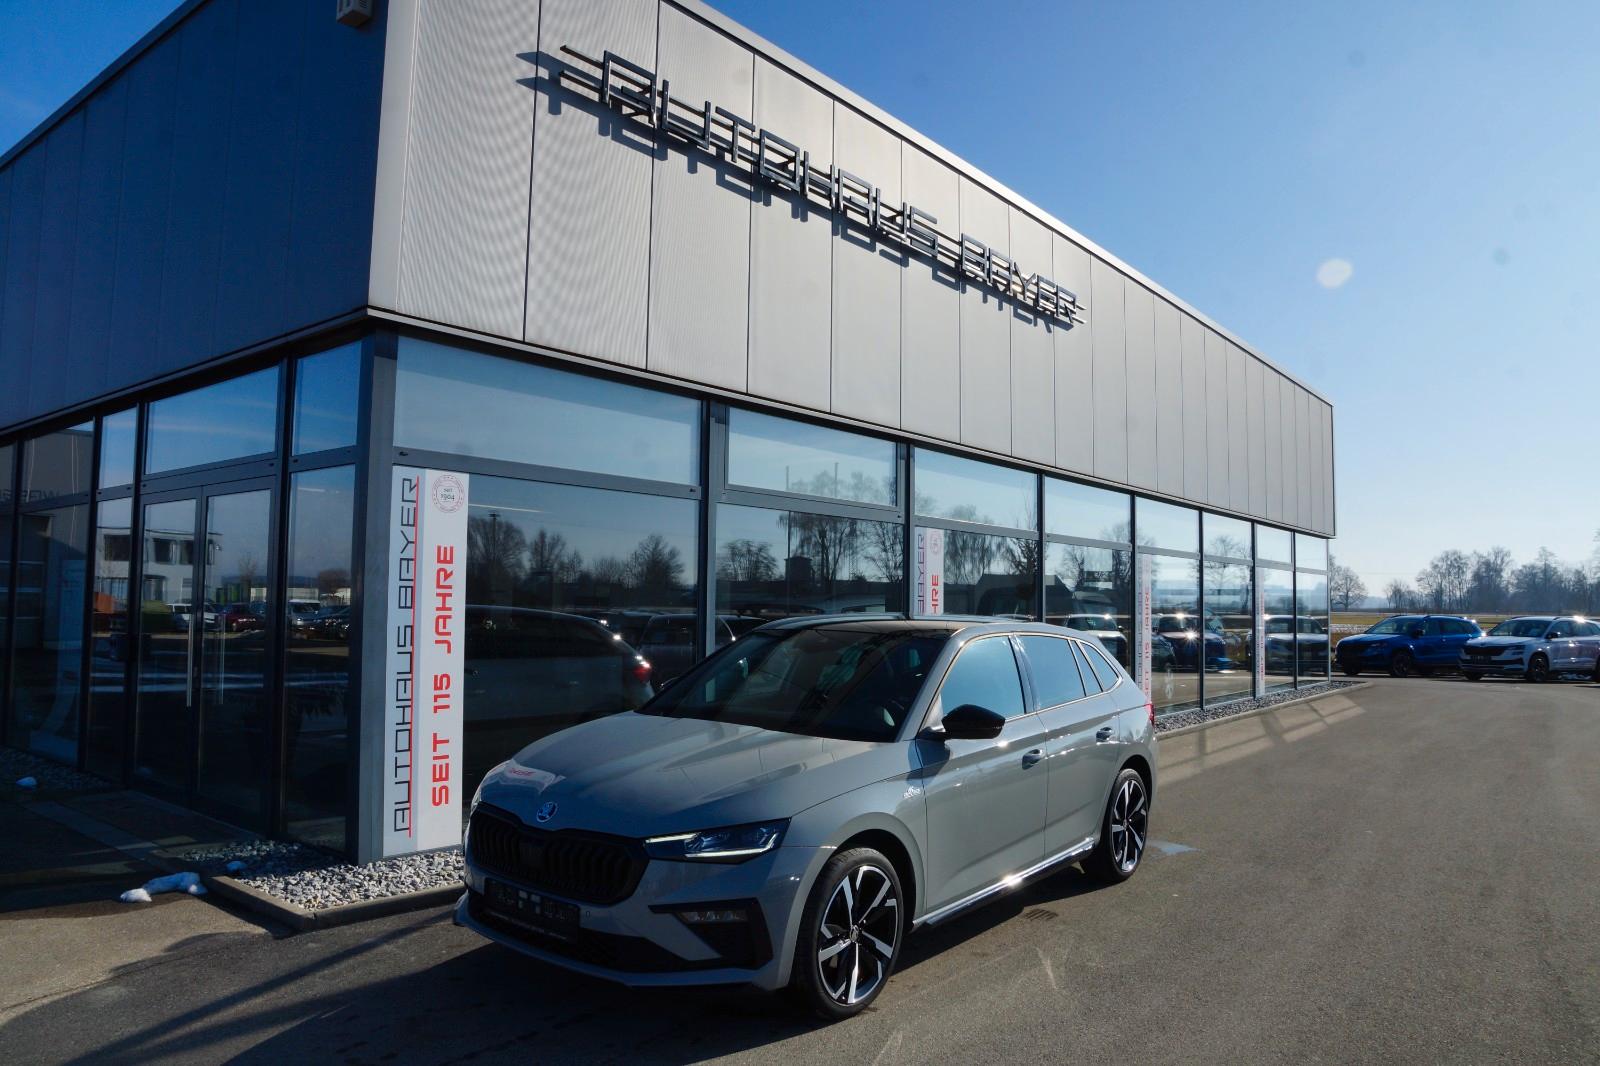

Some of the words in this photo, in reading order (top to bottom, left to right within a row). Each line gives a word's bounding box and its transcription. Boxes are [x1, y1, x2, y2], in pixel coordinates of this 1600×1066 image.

[602, 50, 938, 258] AUTOHAUS
[961, 232, 1077, 323] BAYER
[398, 478, 417, 609] BAYER
[434, 545, 454, 654] JAHRE
[394, 625, 413, 832] AUTOHAUS
[433, 673, 451, 713] 115
[432, 733, 450, 806] SEIT
